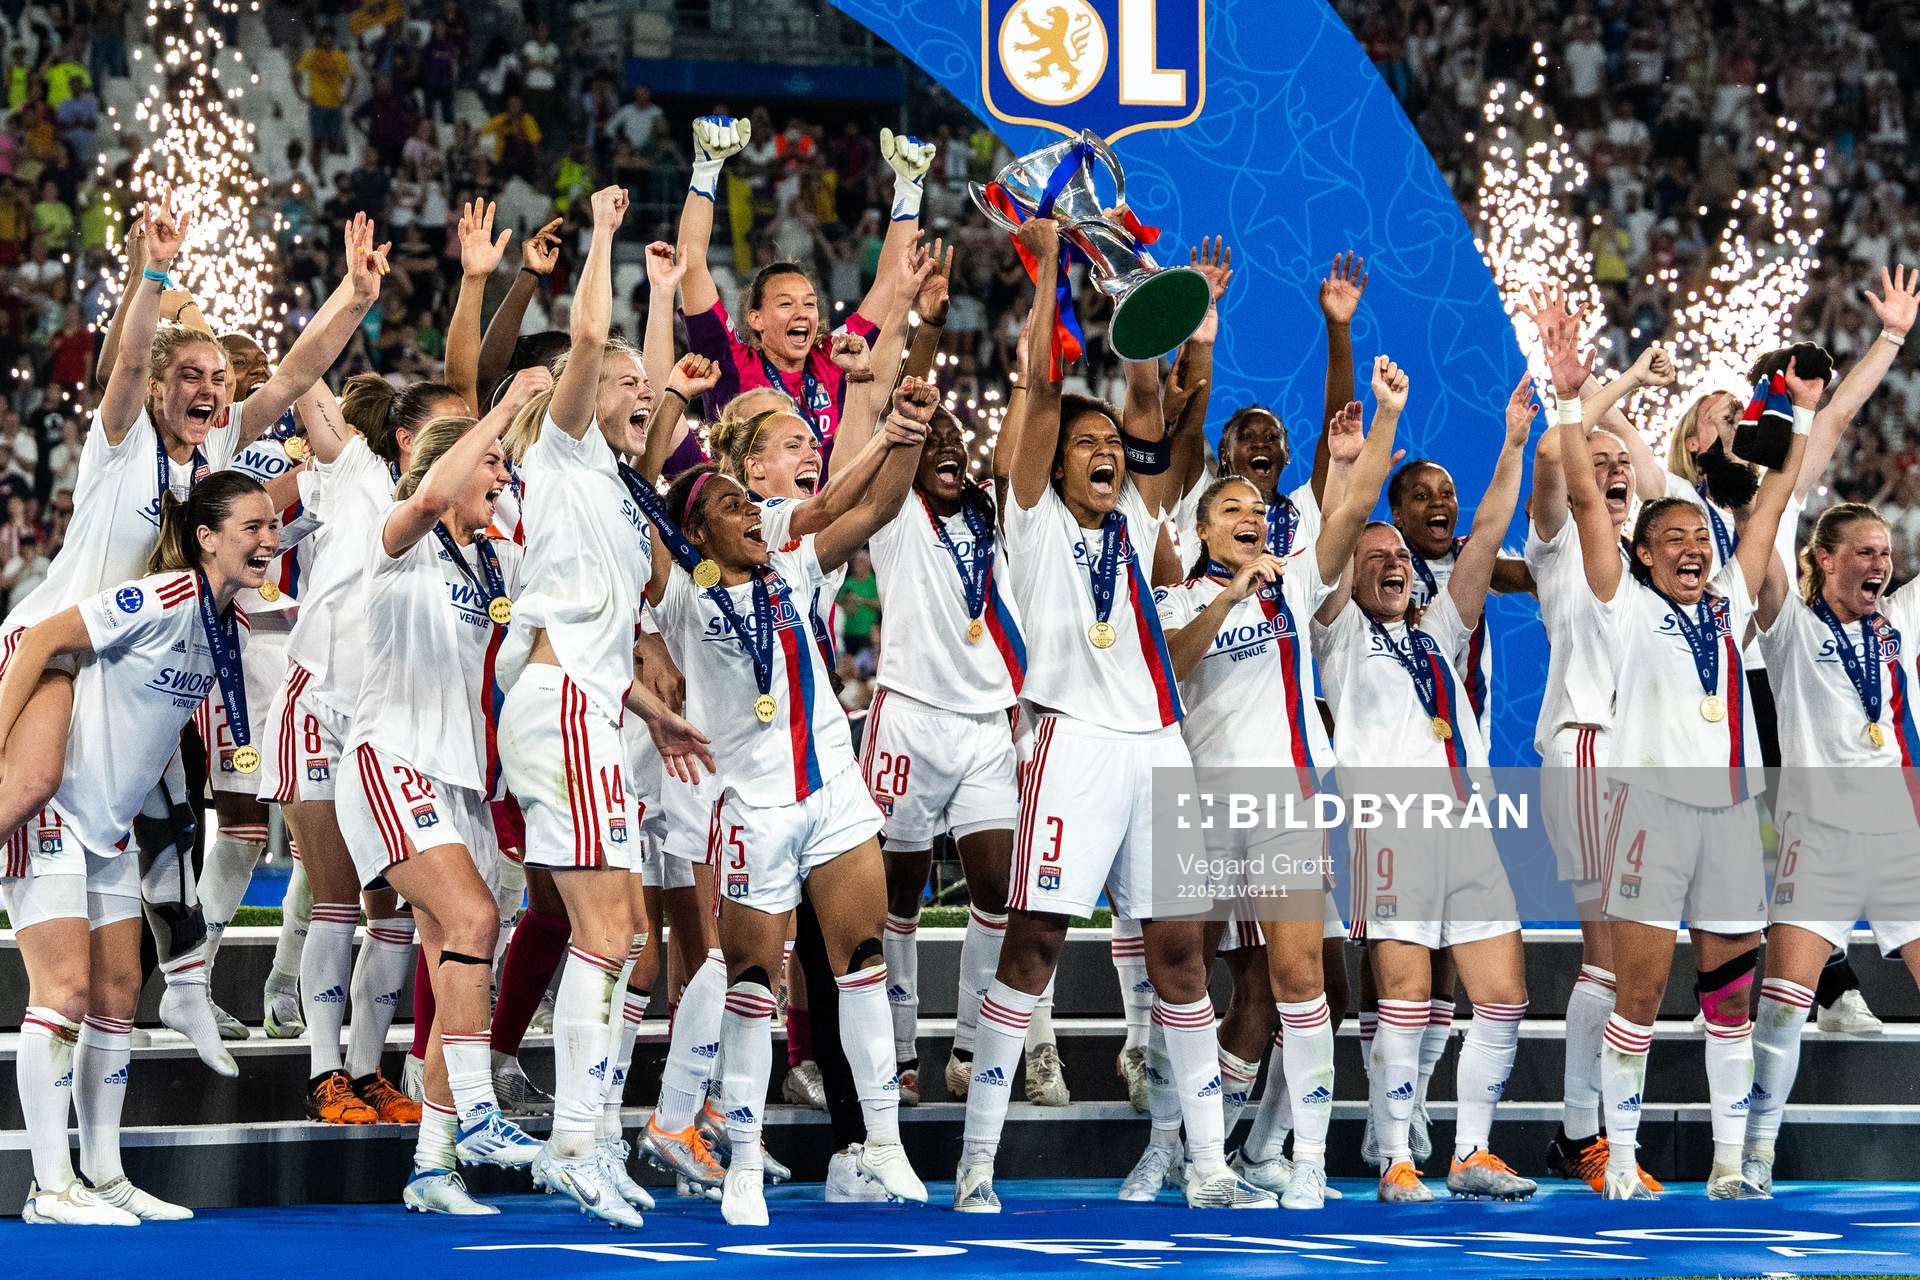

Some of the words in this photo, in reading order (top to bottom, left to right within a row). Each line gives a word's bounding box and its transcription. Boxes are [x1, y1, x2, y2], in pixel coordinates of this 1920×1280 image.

[652, 510, 659, 519] 22
[208, 617, 216, 625] 22
[459, 611, 490, 629] VENUE
[1215, 614, 1288, 648] WORD
[1230, 644, 1267, 662] VENUE
[153, 668, 214, 694] SWOR
[173, 697, 197, 710] VENUE
[233, 711, 240, 720] 22
[236, 723, 245, 743] FINA
[304, 714, 321, 754] 8
[600, 764, 625, 813] 14
[876, 752, 911, 796] 28
[728, 825, 746, 870] 5
[1043, 816, 1064, 862] 3
[1626, 830, 1646, 873] 4
[1376, 847, 1394, 891] 9
[1782, 838, 1801, 877] 6
[104, 1076, 127, 1084] adid
[453, 1228, 1843, 1262] TORiNO
[1076, 1246, 1909, 1269] FINA
